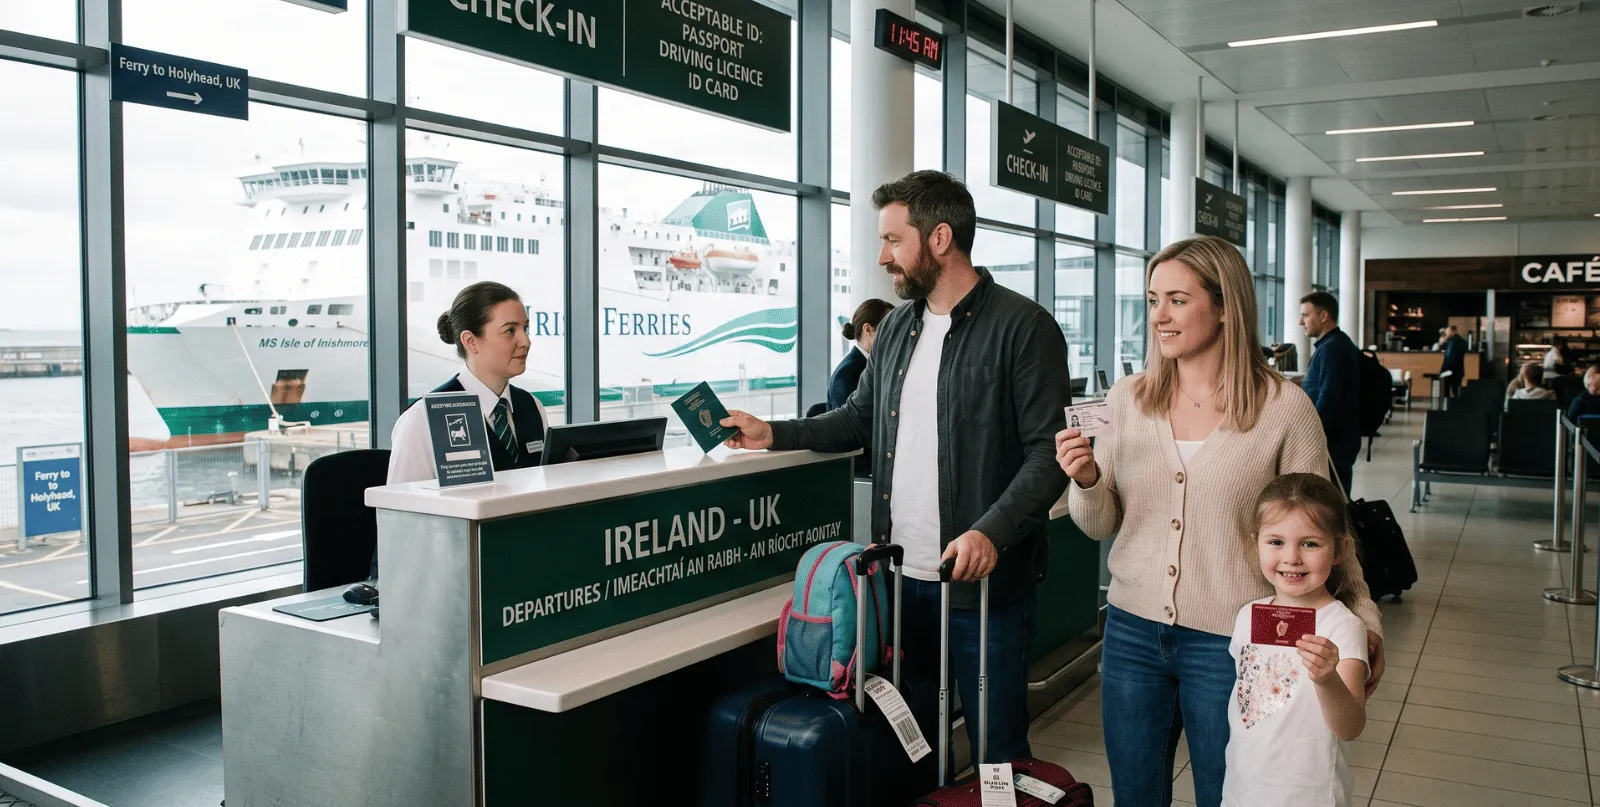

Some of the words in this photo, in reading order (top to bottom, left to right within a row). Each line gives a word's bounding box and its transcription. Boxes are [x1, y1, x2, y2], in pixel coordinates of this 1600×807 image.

[661, 0, 743, 37] ACCEPTABLE
[746, 23, 763, 44] ID:
[682, 23, 745, 59] PASSPORT
[891, 23, 920, 53] 11:45
[923, 36, 939, 60] AM
[119, 56, 150, 76] Ferry
[152, 63, 165, 76] to
[168, 65, 223, 88] Holyhead,
[226, 76, 241, 90] UK
[660, 39, 713, 72] DRIVING
[717, 57, 763, 88] LICENCE
[688, 72, 702, 90] ID
[705, 78, 739, 101] CARD
[1006, 154, 1049, 184] CHECK-IN
[1521, 256, 1600, 283] CAFÉ
[603, 307, 692, 336] FERRIES
[259, 338, 278, 348] MS
[280, 338, 300, 348] Isle
[303, 338, 316, 348] of
[317, 338, 369, 348] Inishmore
[35, 471, 59, 481] Ferry
[60, 470, 70, 478] to
[48, 482, 58, 490] to
[30, 489, 76, 502] Holyhead,
[46, 502, 60, 511] UK
[604, 506, 726, 566] IRELAND
[750, 493, 781, 531] UK
[502, 582, 601, 627] DEPARTURES
[604, 580, 610, 600] /
[613, 556, 684, 597] IMEACHTAÍ
[687, 553, 704, 577] AN
[707, 547, 741, 571] RAIBH
[750, 541, 765, 560] AN
[768, 530, 804, 554] RÍOCHT
[805, 521, 842, 545] AONTAY
